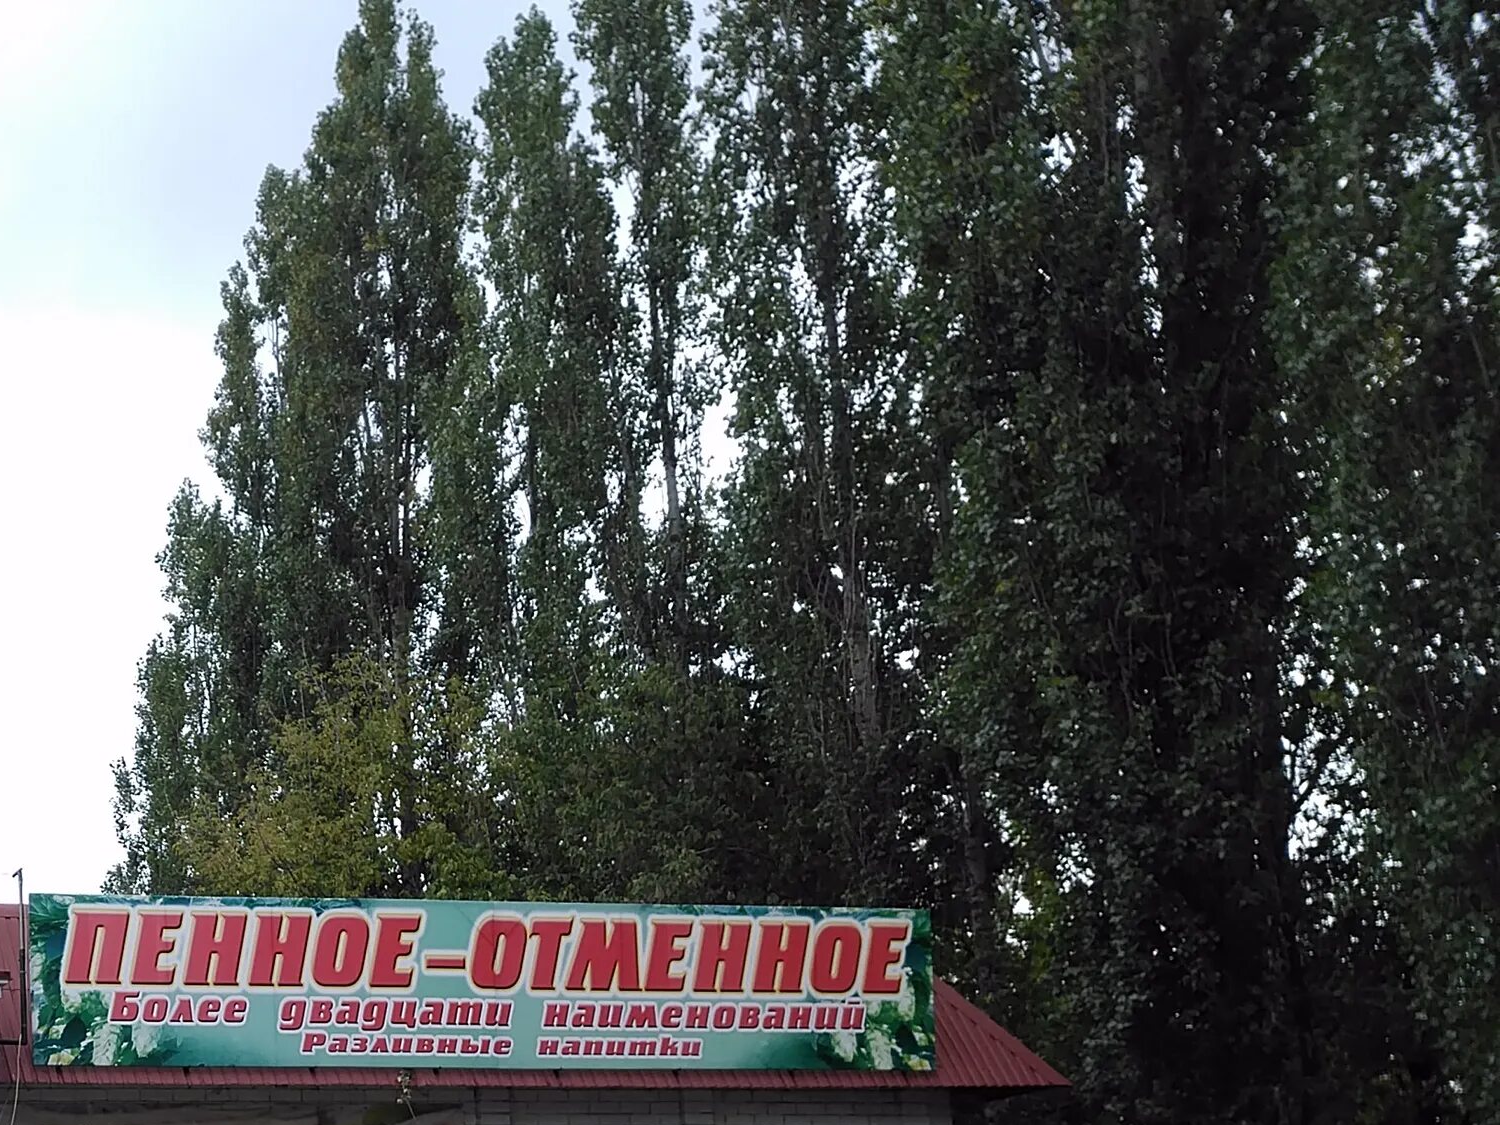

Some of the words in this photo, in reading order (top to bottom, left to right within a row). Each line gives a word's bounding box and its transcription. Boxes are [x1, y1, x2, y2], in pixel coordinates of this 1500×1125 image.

[110, 991, 248, 1024] Более
[279, 999, 512, 1032] двадцати
[543, 998, 866, 1032] наименований
[301, 1032, 512, 1057] Разливные
[537, 1035, 703, 1058] напитки
